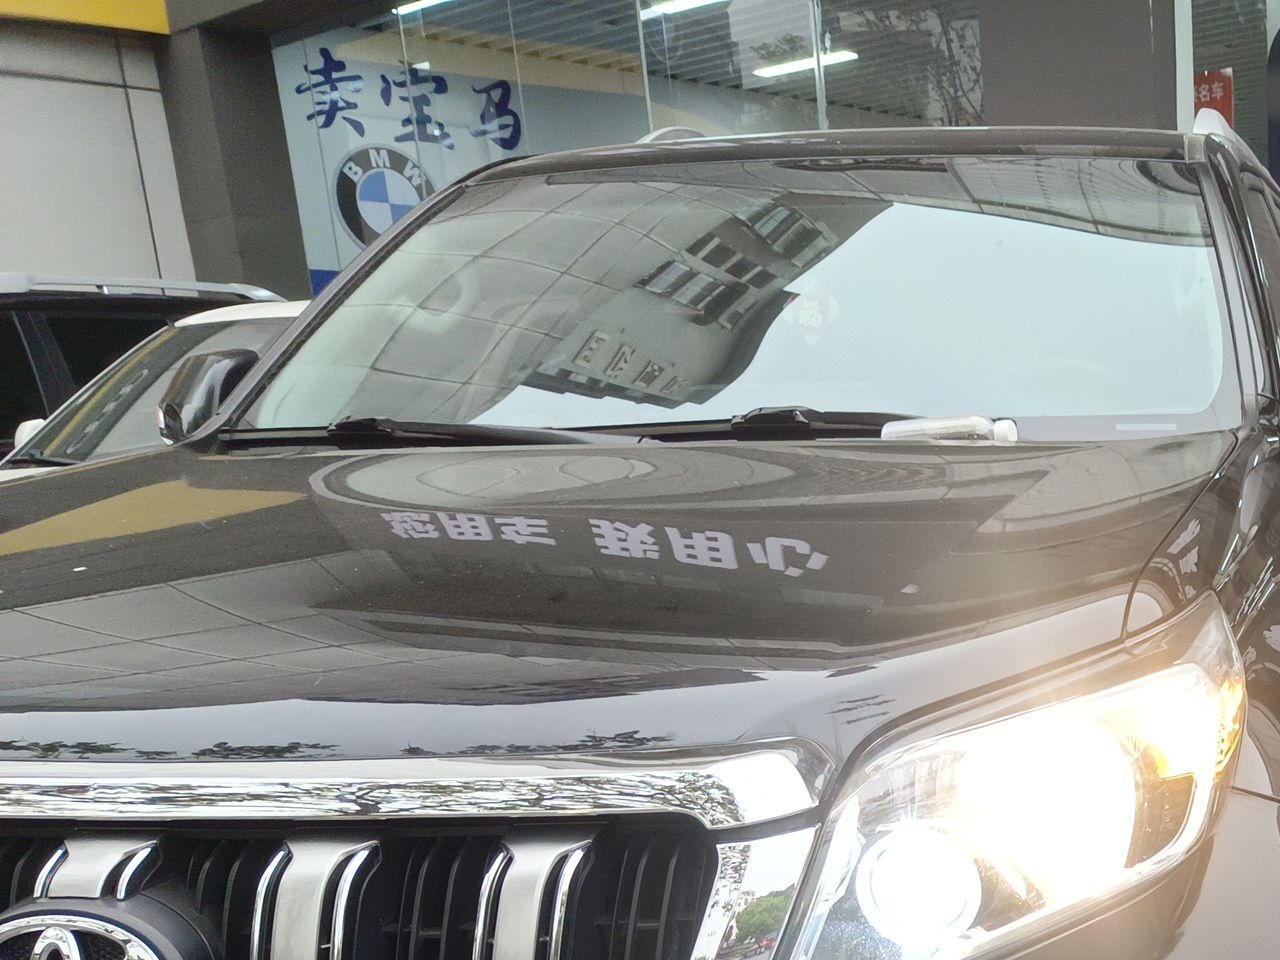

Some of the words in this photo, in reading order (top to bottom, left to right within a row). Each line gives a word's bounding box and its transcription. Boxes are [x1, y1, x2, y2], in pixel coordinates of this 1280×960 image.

[295, 47, 521, 150] 卖宝马
[341, 148, 425, 187] BMW
